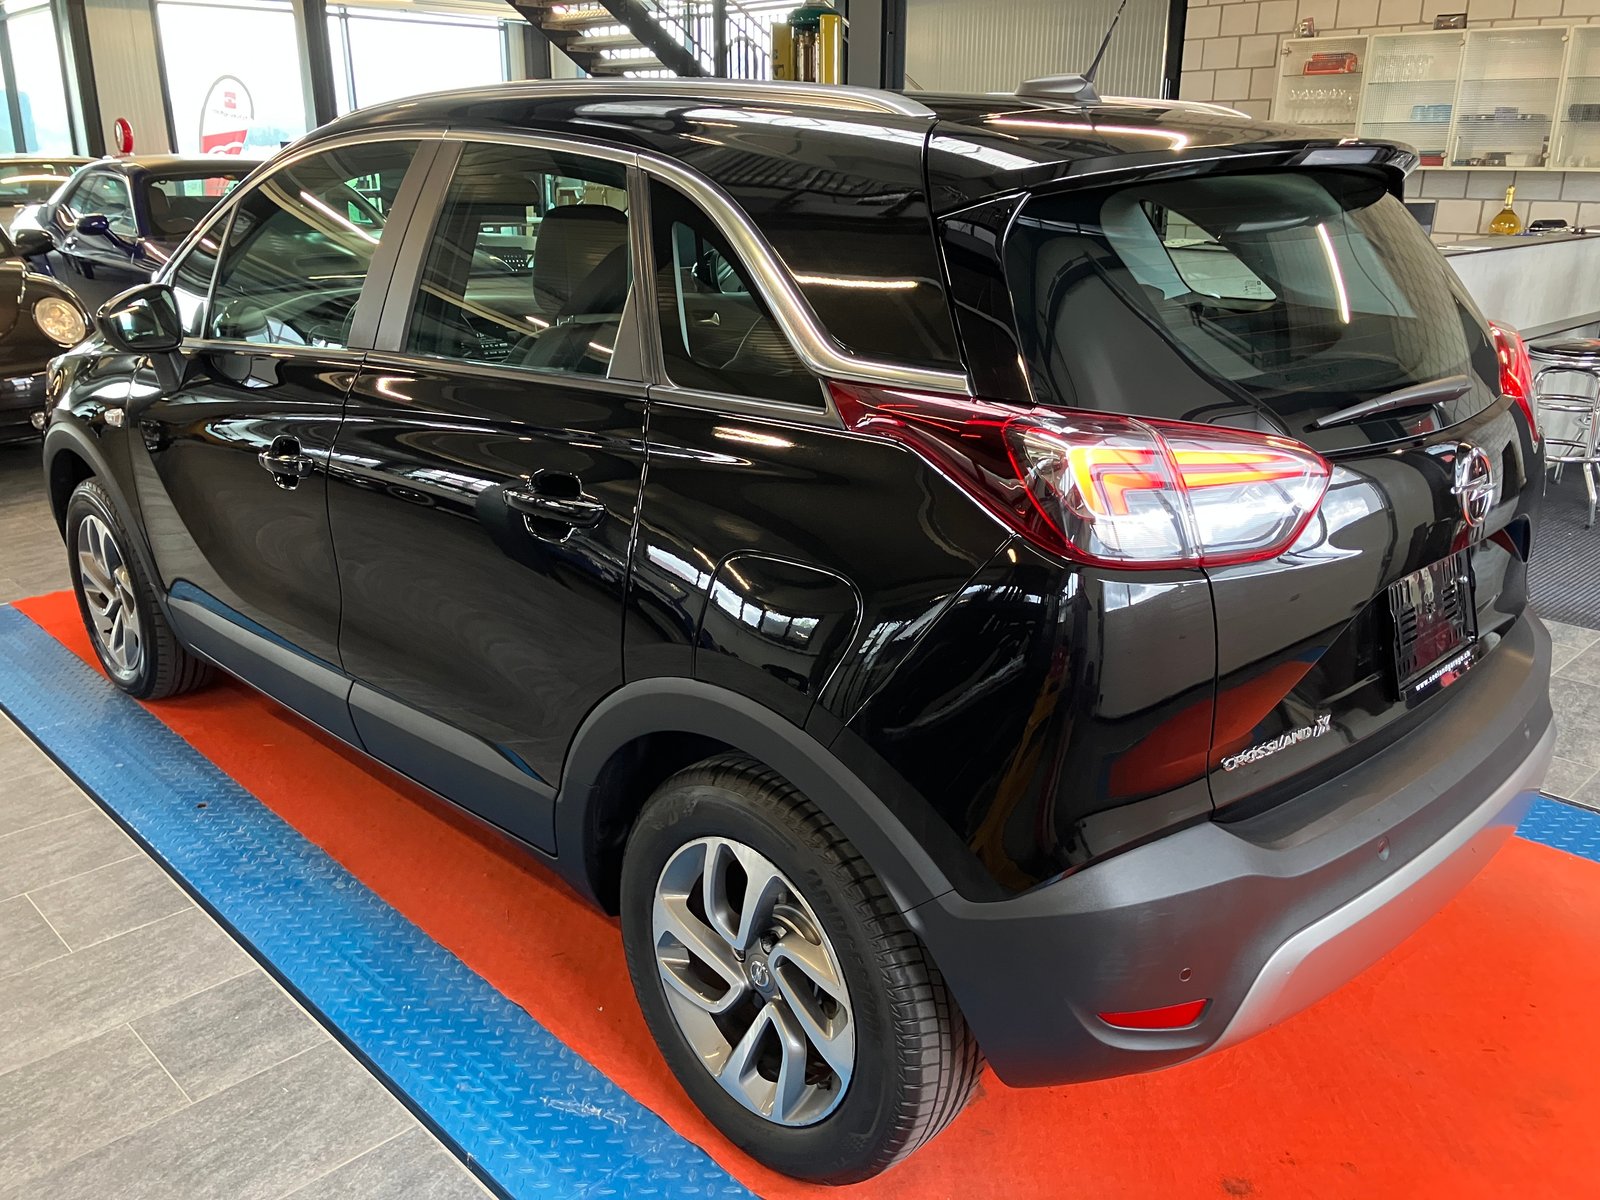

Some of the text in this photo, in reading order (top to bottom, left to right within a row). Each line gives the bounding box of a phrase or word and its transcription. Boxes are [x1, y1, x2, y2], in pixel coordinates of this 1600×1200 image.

[1415, 650, 1471, 692] www.seelandgarage.ch
[1221, 714, 1332, 772] CROSSLAND X
